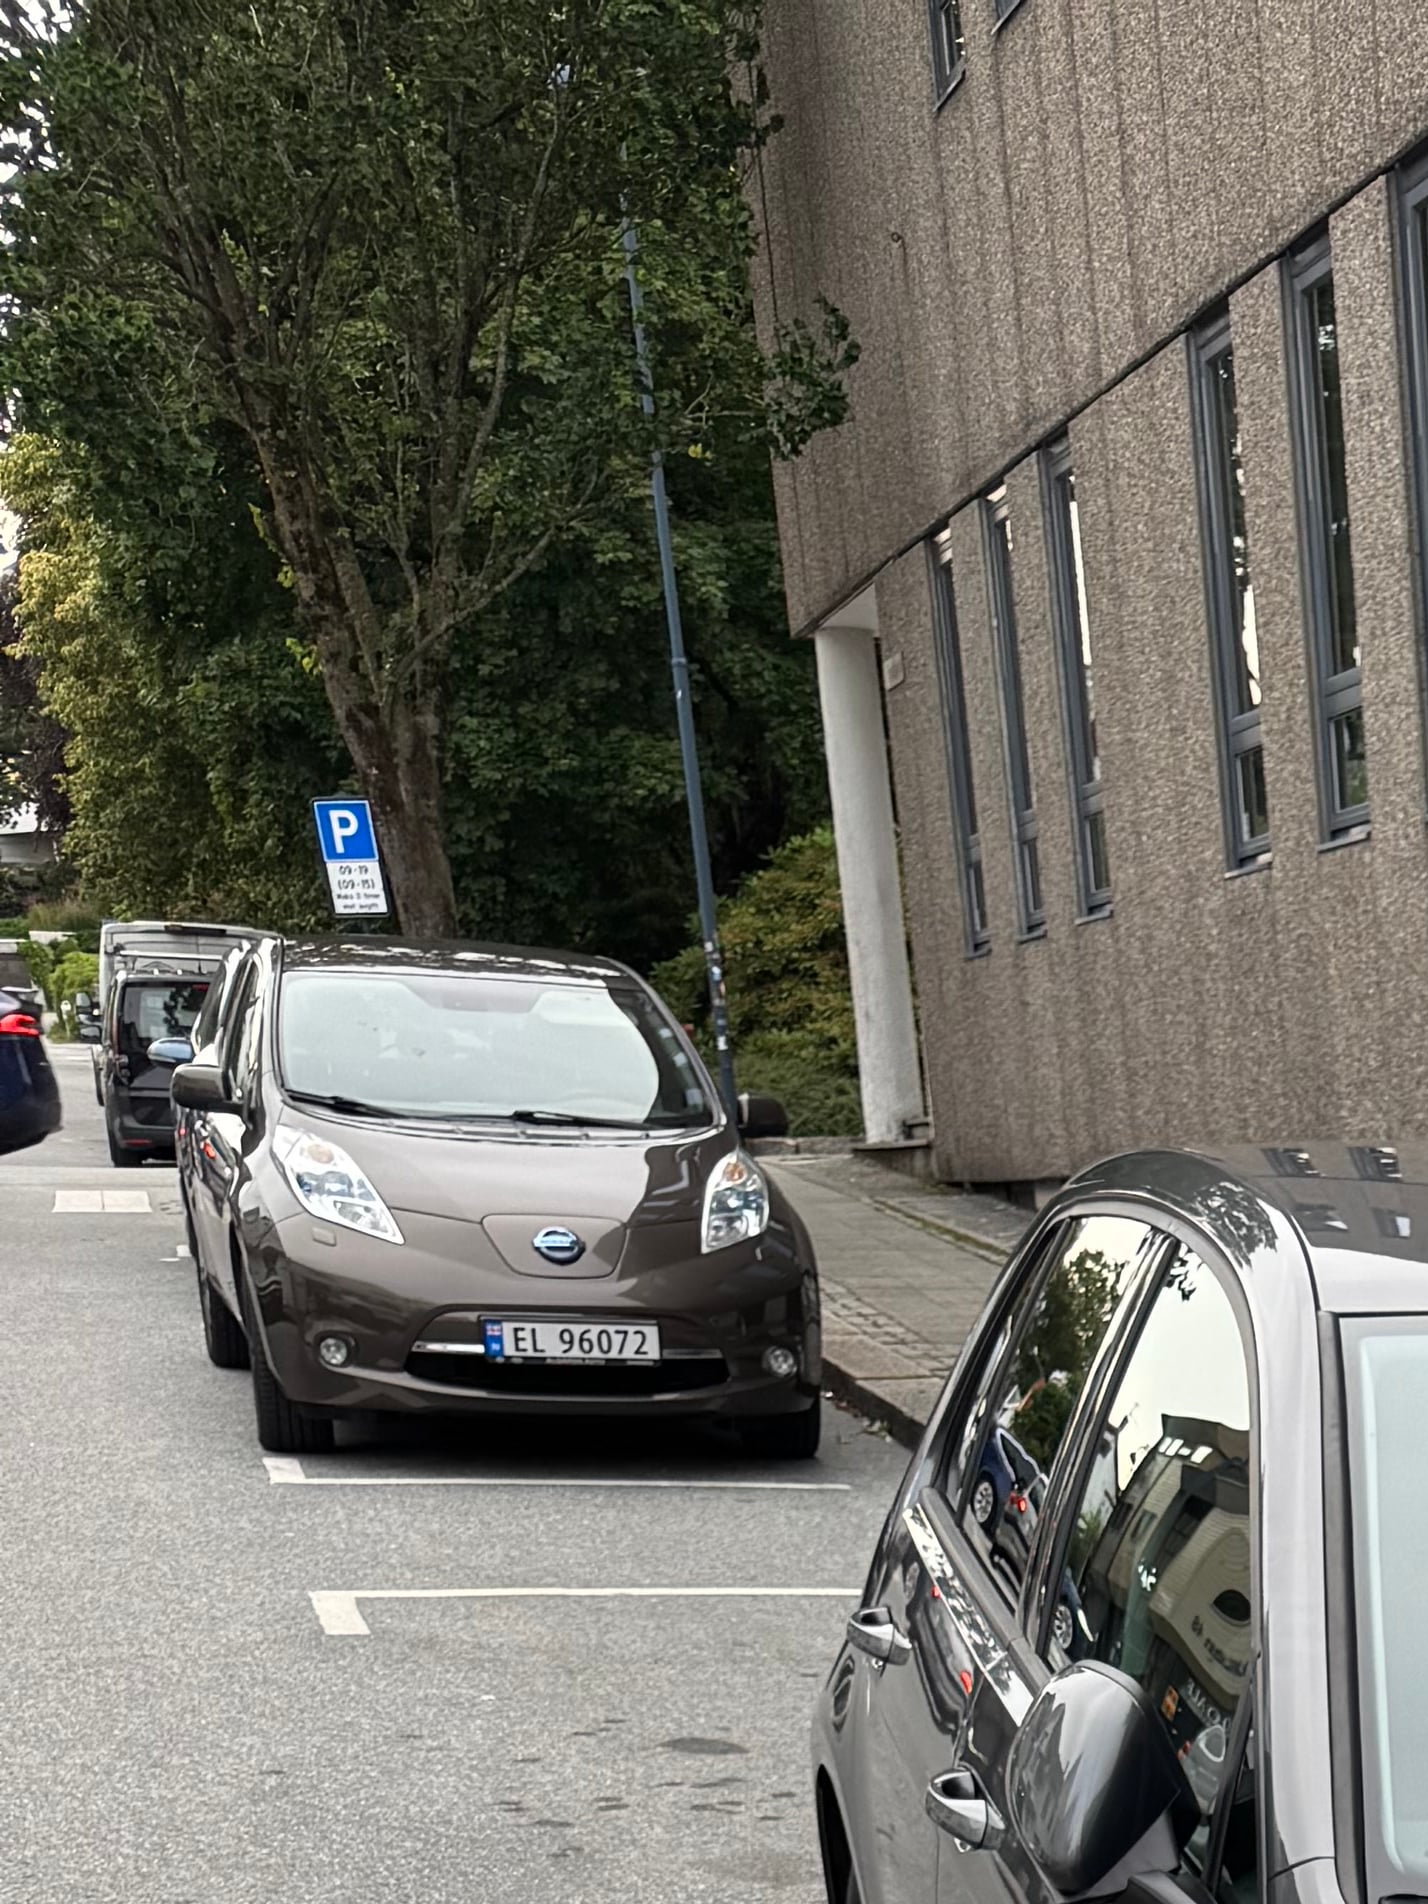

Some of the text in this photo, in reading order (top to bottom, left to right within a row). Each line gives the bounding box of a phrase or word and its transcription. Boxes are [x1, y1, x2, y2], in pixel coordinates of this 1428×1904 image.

[328, 809, 359, 854] P
[512, 1327, 648, 1356] EL 96072
